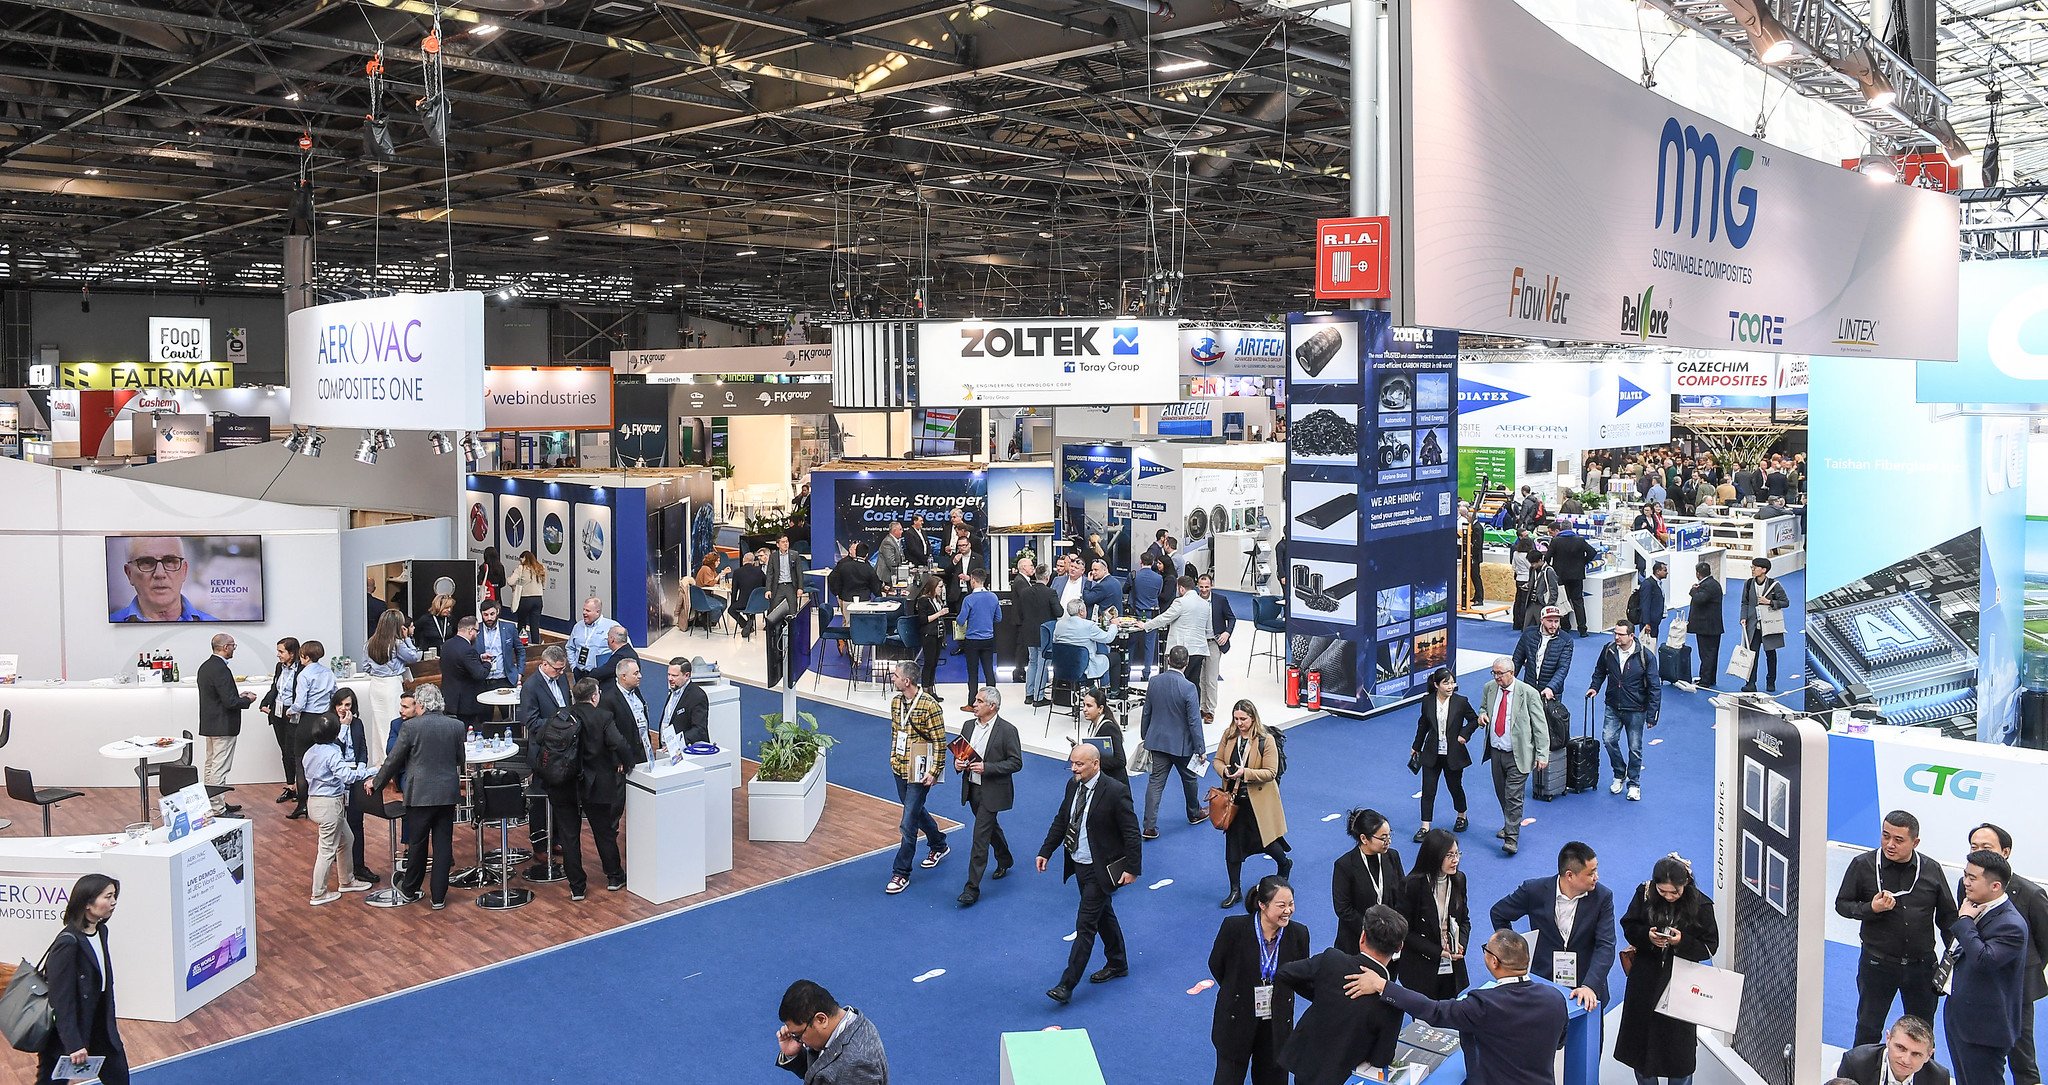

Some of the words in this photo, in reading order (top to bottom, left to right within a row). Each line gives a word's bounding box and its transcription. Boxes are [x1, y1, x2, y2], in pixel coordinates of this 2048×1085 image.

[1324, 232, 1378, 244] R.I.A.
[1652, 248, 1702, 276] SUSTAINABLE
[1704, 260, 1752, 284] COMPOSITES
[1509, 267, 1570, 324] FlowVac
[161, 328, 200, 347] FOOD
[1393, 328, 1424, 342] ZOLTEK
[1838, 318, 1876, 342] LINTEX
[318, 319, 422, 364] AEROVAC
[961, 327, 1100, 357] ZOLTEK
[1235, 338, 1284, 356] AIRTECH
[162, 346, 200, 359] Court
[1080, 362, 1106, 372] Toray
[1108, 362, 1140, 372] Group
[1678, 362, 1749, 372] GAZECHIM
[111, 368, 230, 388] FAIRMAT
[1678, 375, 1767, 386] COMPOSITES
[318, 377, 386, 400] COMPOSITES
[390, 377, 423, 401] ONE
[1459, 392, 1509, 401] DIATEX
[1620, 391, 1643, 400] DIATEX
[493, 391, 597, 405] webindustries
[1162, 402, 1209, 416] AIRTECH
[1824, 458, 1870, 470] Taishan
[851, 493, 910, 508] Lighter,
[914, 494, 985, 508] Stronger,
[1371, 498, 1382, 507] WE
[1383, 495, 1396, 505] ARE
[1398, 492, 1421, 503] HIRING!
[1371, 513, 1382, 521] Send
[1383, 512, 1392, 520] your
[1853, 606, 1934, 654] AI
[1904, 763, 1982, 801] CTG
[1716, 838, 1724, 890] Carbon
[187, 877, 197, 886] LIVE
[199, 868, 216, 881] DEMOS
[0, 884, 69, 904] EROVA
